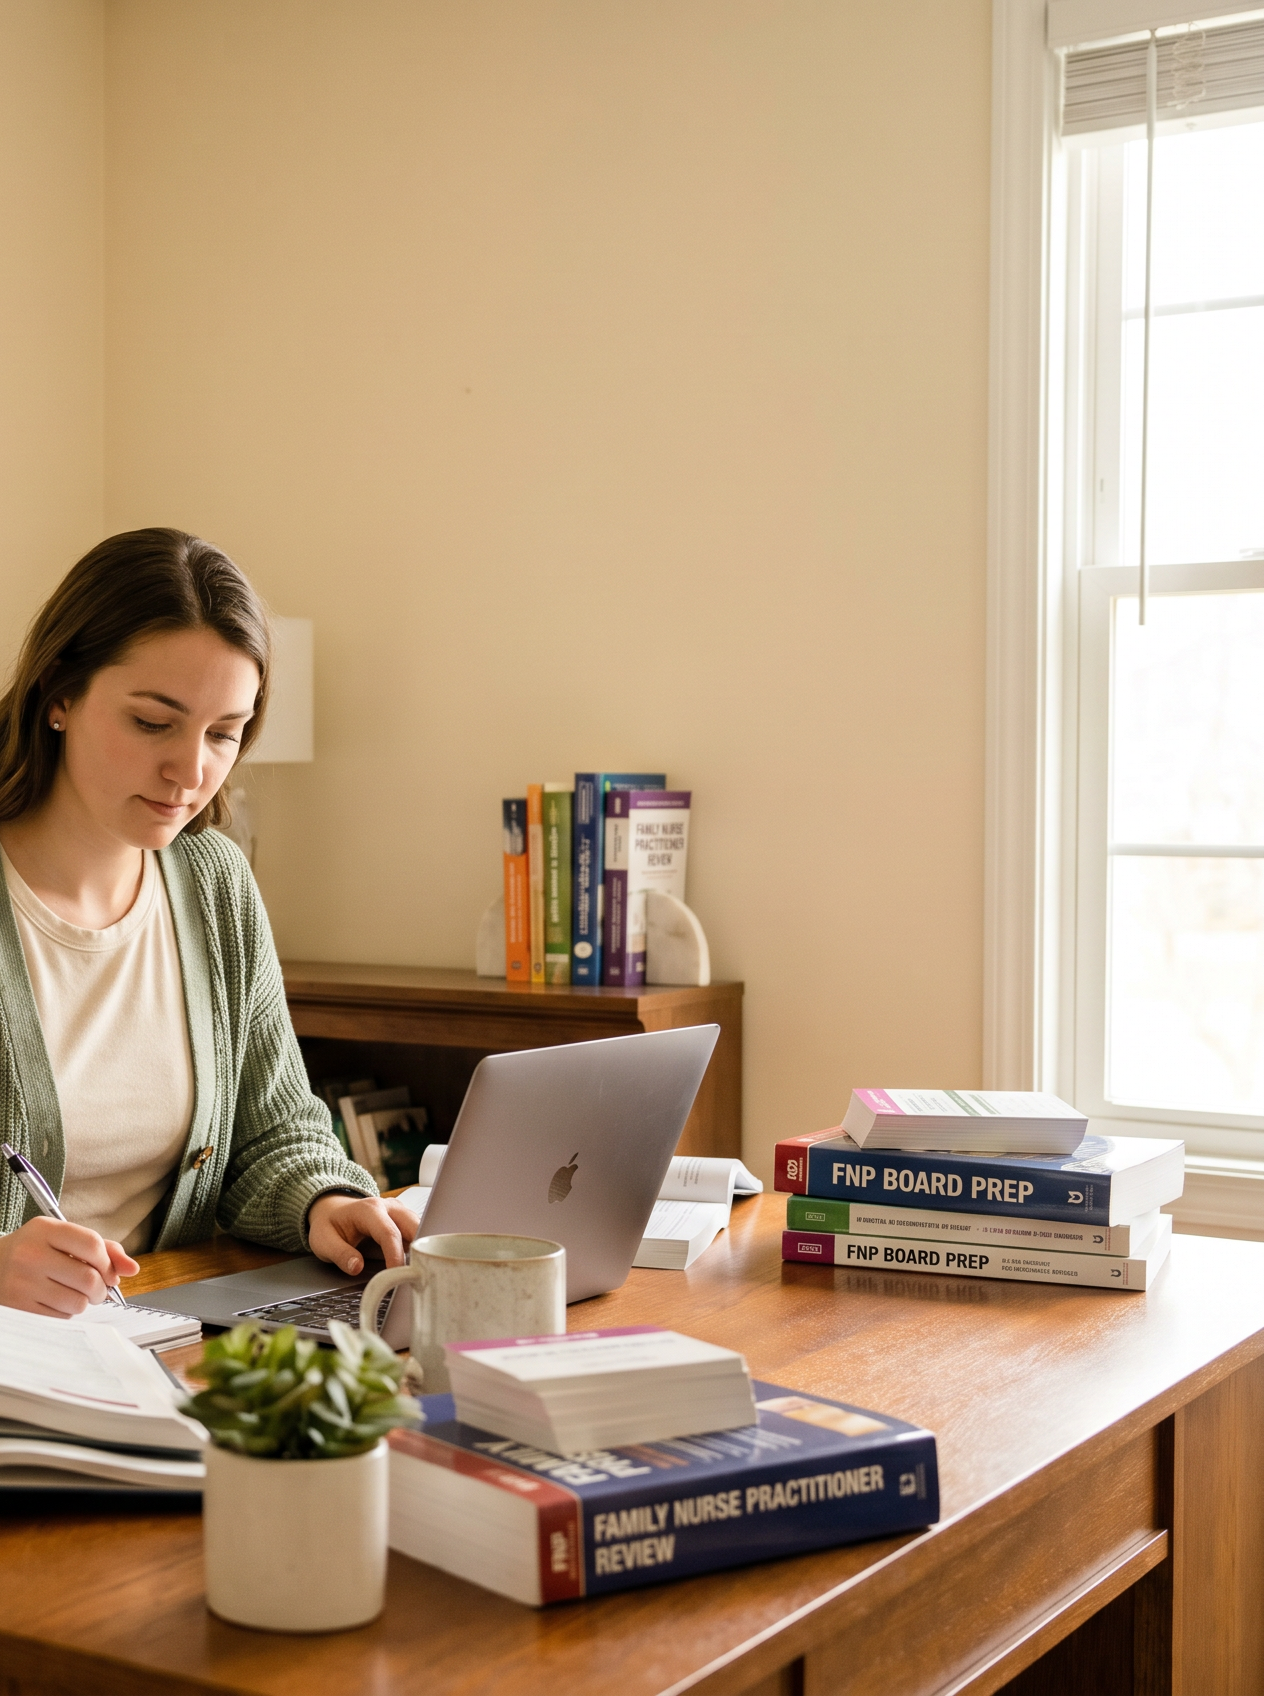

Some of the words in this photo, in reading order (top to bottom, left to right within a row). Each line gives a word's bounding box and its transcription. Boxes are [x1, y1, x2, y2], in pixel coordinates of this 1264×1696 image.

[832, 1162, 876, 1188] FNP
[883, 1167, 963, 1197] BOARD
[971, 1176, 1034, 1204] PREP
[847, 1244, 879, 1261] FNP
[883, 1247, 941, 1266] BOARD
[945, 1252, 990, 1270] PREP
[593, 1503, 670, 1544] FAMILY
[673, 1489, 742, 1528] NURSE
[745, 1464, 885, 1515] PRACTITIONER
[594, 1534, 676, 1577] REVIEW
